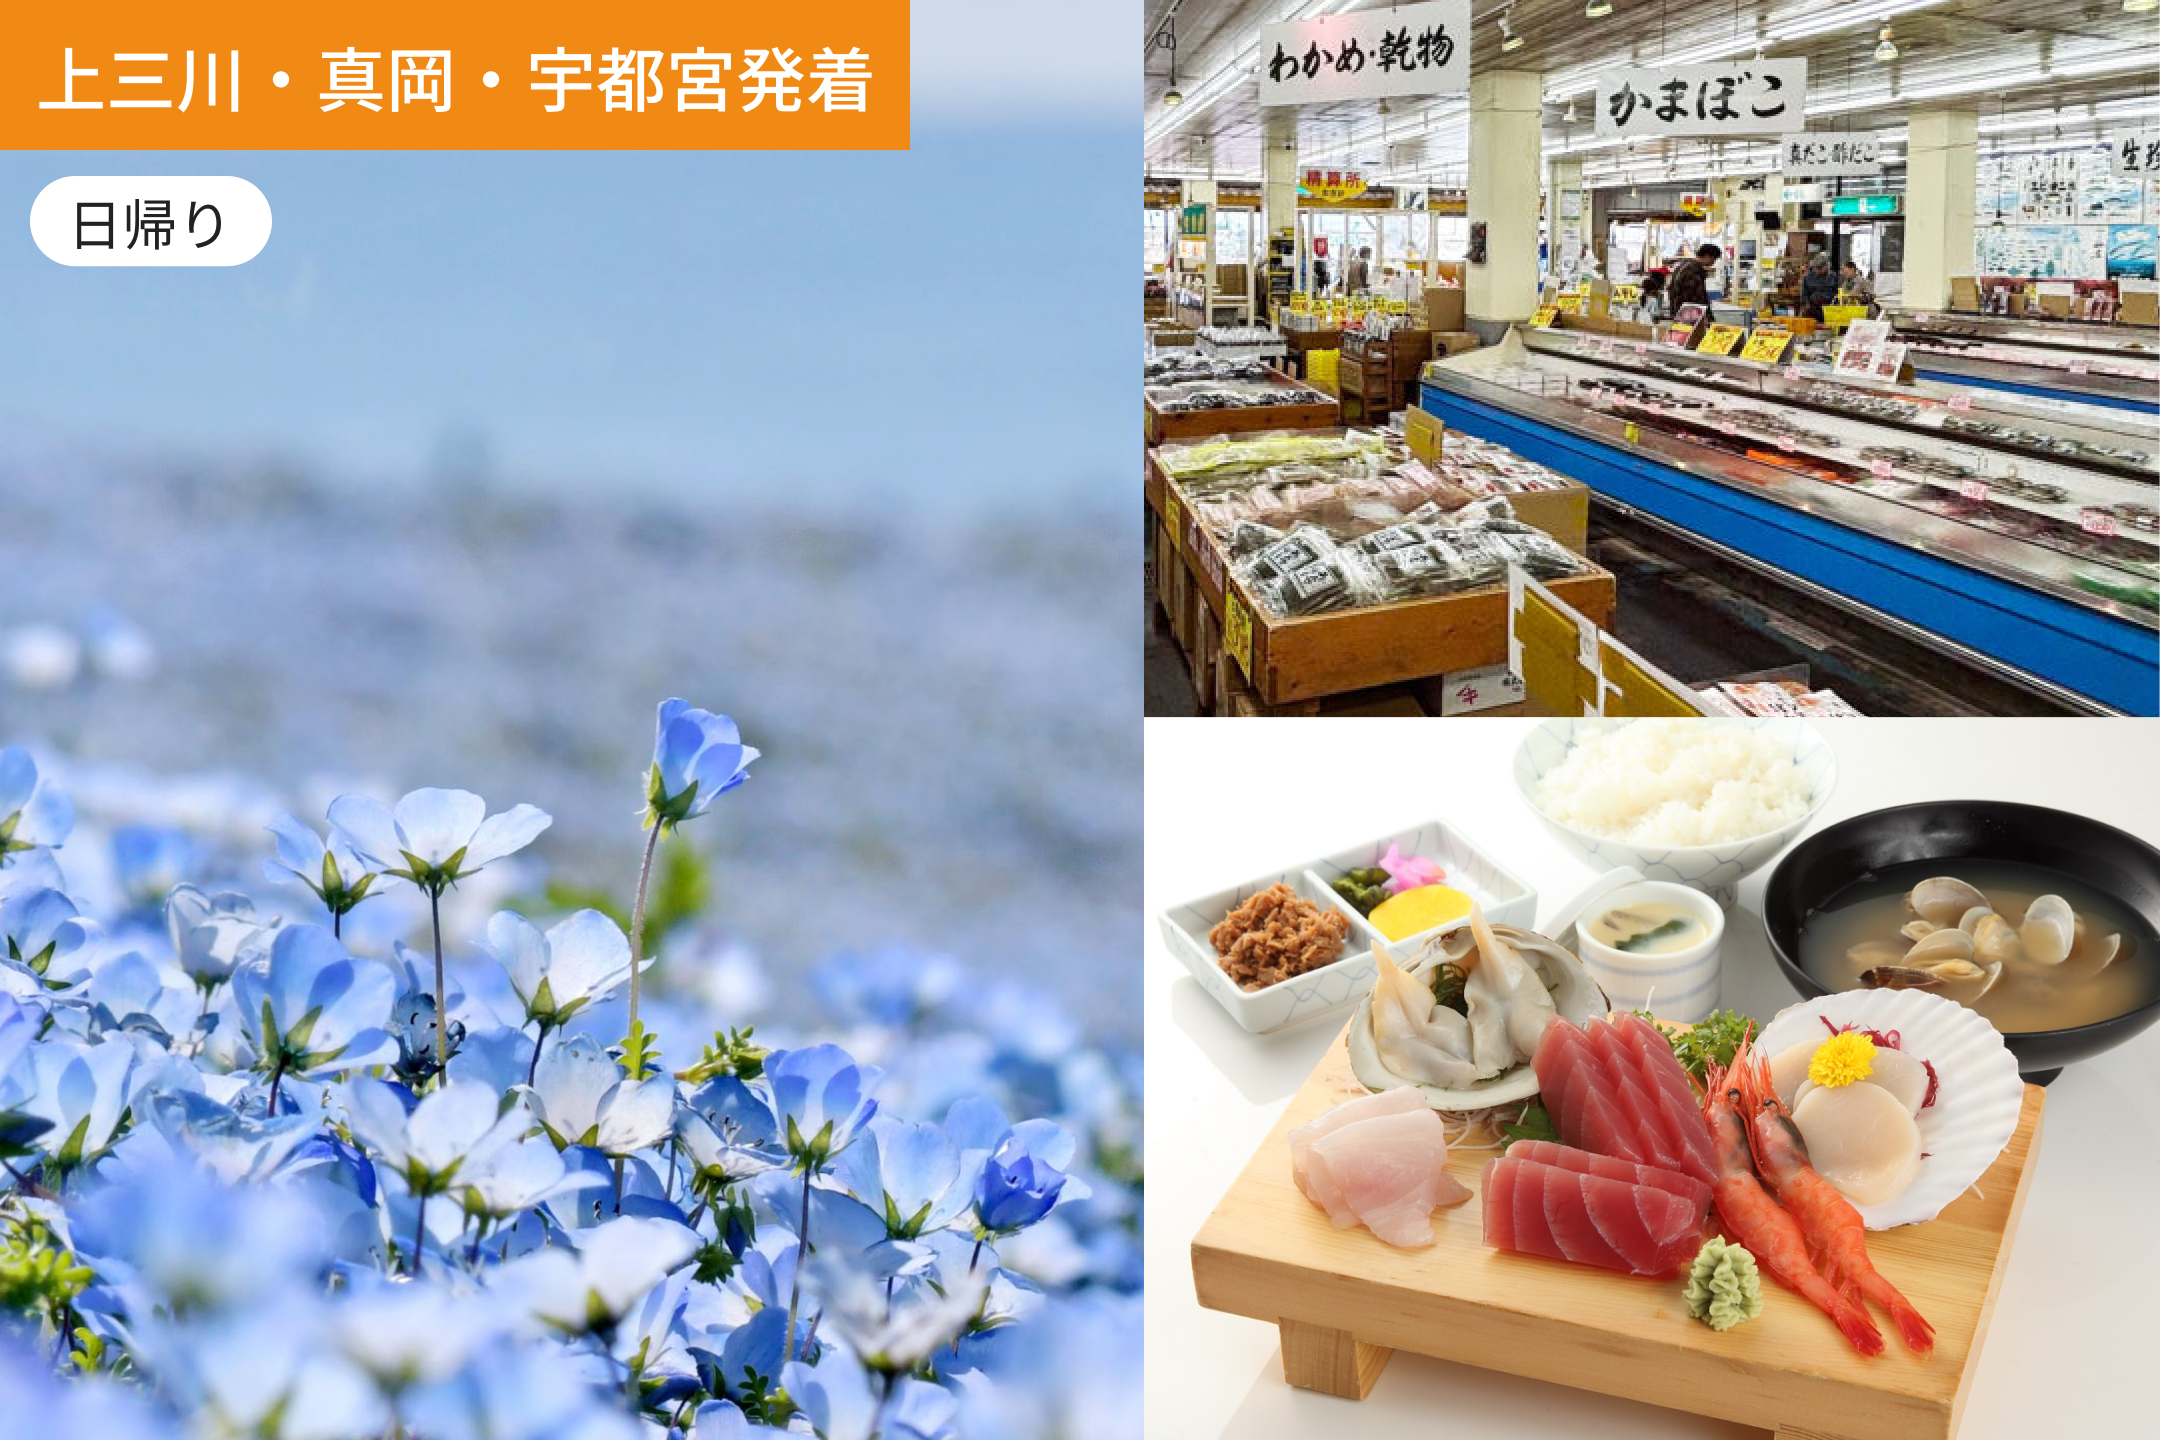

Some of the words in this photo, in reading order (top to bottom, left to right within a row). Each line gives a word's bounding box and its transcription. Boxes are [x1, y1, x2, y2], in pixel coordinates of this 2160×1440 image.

[1269, 23, 1455, 83] わかめ・乾物
[1609, 71, 1785, 127] かまぼこ
